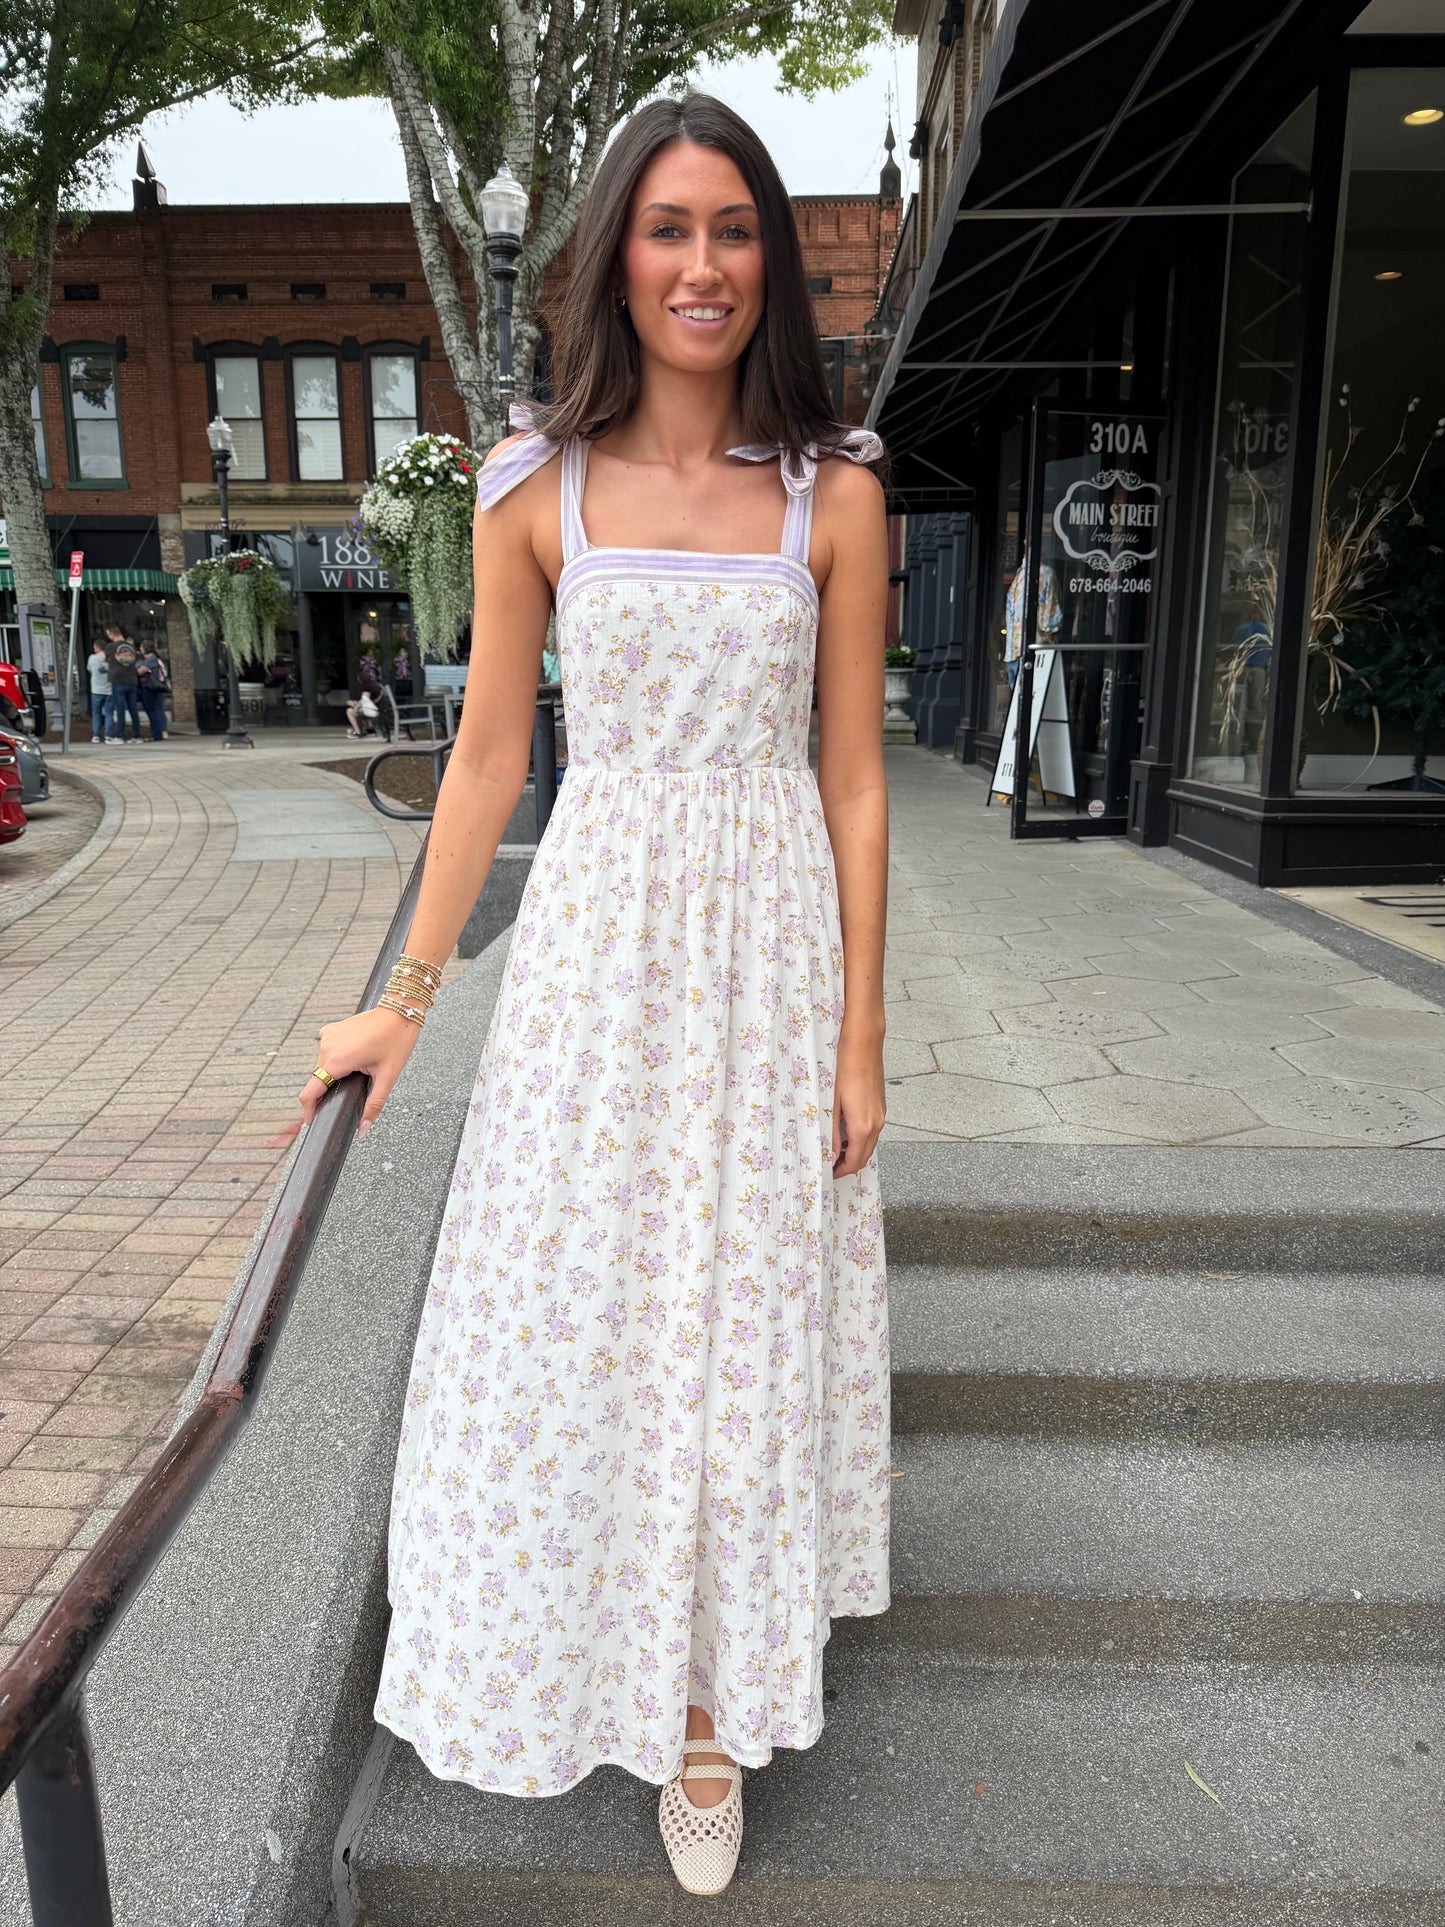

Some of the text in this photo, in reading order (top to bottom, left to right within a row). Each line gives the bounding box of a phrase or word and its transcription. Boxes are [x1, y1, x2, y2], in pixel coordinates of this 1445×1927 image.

[1090, 422, 1148, 454] 310A
[1069, 502, 1160, 527] MAIN STREET
[1091, 526, 1140, 548] boutique
[318, 535, 372, 565] 188
[320, 569, 390, 589] WINE
[1069, 578, 1152, 593] 678-664-2046
